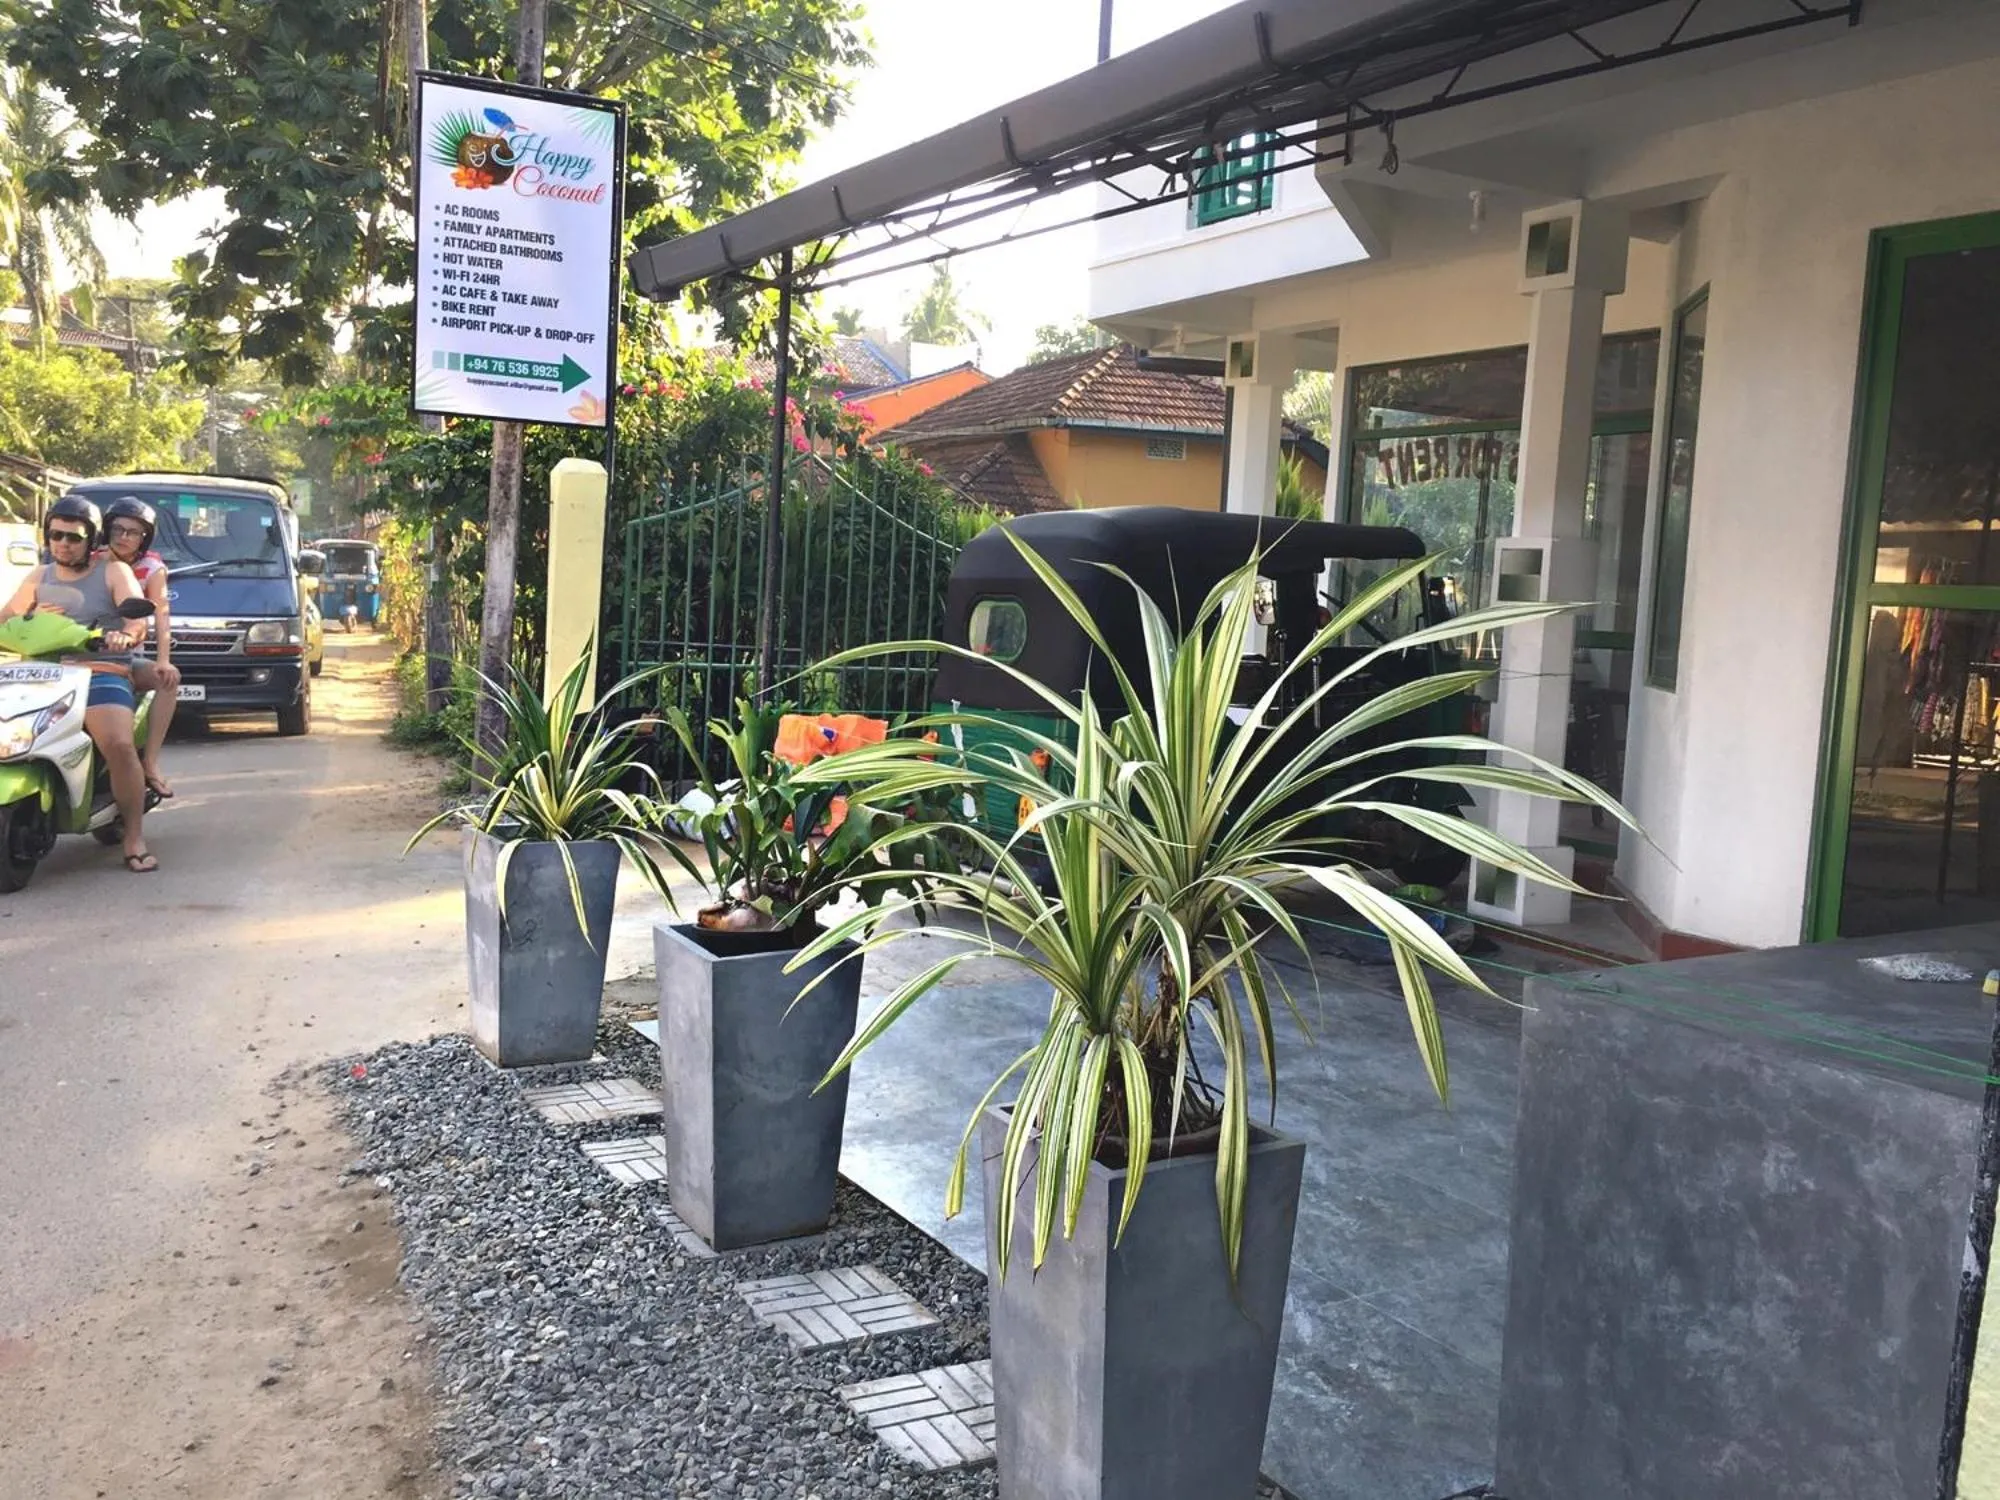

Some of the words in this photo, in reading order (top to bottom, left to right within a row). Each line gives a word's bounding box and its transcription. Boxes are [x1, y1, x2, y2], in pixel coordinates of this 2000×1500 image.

[491, 133, 596, 181] Happy
[513, 165, 605, 204] Coconut
[444, 203, 459, 216] AC
[462, 206, 500, 222] ROOMS
[443, 219, 482, 235] FAMILY
[485, 225, 556, 246] APARTMENTS
[442, 252, 464, 265] HOT
[467, 255, 503, 270] WATER
[443, 236, 497, 253] ATTACHED
[499, 243, 564, 263] BATHROOMS
[442, 268, 470, 282] WI-FI
[473, 272, 501, 286] 24HR
[441, 300, 466, 313] BIKE
[469, 303, 496, 317] RENT
[442, 284, 457, 297] AC
[459, 286, 487, 300] CAFE
[490, 289, 498, 302] &
[501, 291, 528, 306] TAKE
[530, 295, 559, 309] AWAY
[441, 316, 487, 332] AIRPORT
[490, 322, 531, 337] PICK-UP
[534, 327, 542, 339] &
[545, 328, 596, 344] DROP-OFF
[467, 358, 488, 370] +94
[492, 360, 505, 373] 76
[508, 362, 529, 375] 536
[532, 365, 560, 378] 9925
